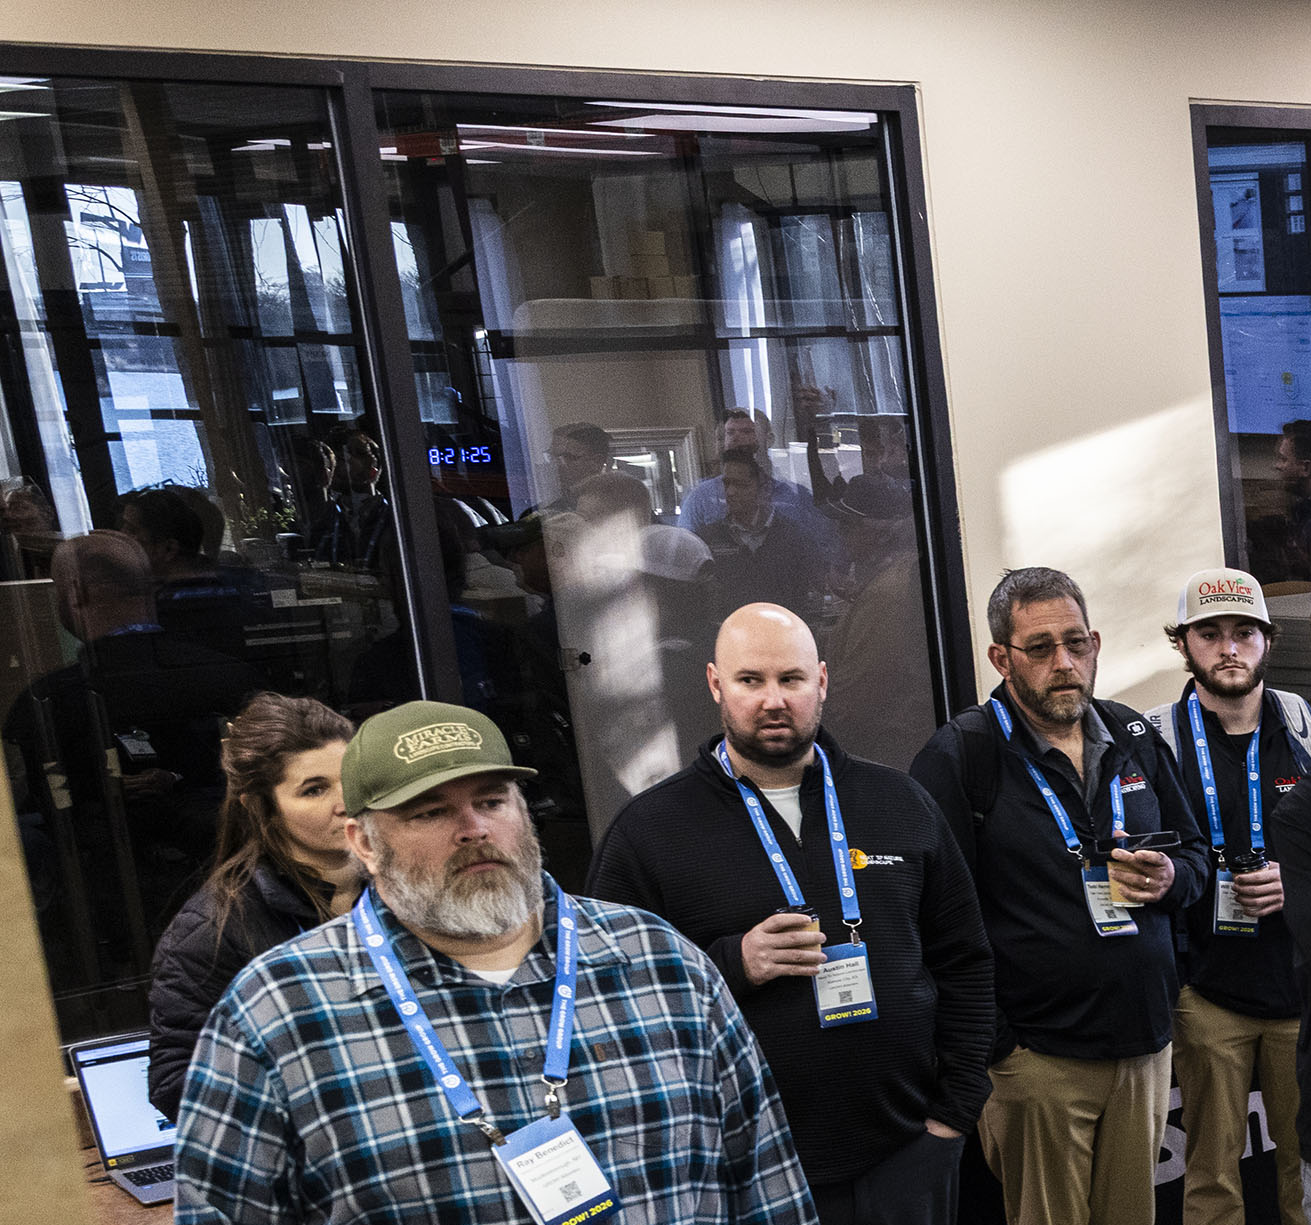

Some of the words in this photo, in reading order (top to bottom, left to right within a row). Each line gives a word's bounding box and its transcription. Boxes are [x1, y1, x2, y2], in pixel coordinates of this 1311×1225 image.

[428, 446, 492, 466] 8:21:25
[1198, 581, 1225, 597] Oak
[1225, 579, 1253, 596] View
[1200, 596, 1254, 606] LANDSCAPING
[404, 726, 468, 746] MIRACLE
[407, 734, 473, 753] FARMS
[823, 964, 845, 974] Austin
[824, 1011, 853, 1021] GROW!
[852, 1007, 872, 1017] 2026
[516, 1157, 535, 1169] Ray
[534, 1136, 574, 1160] Benedict
[589, 1199, 614, 1216] 2026
